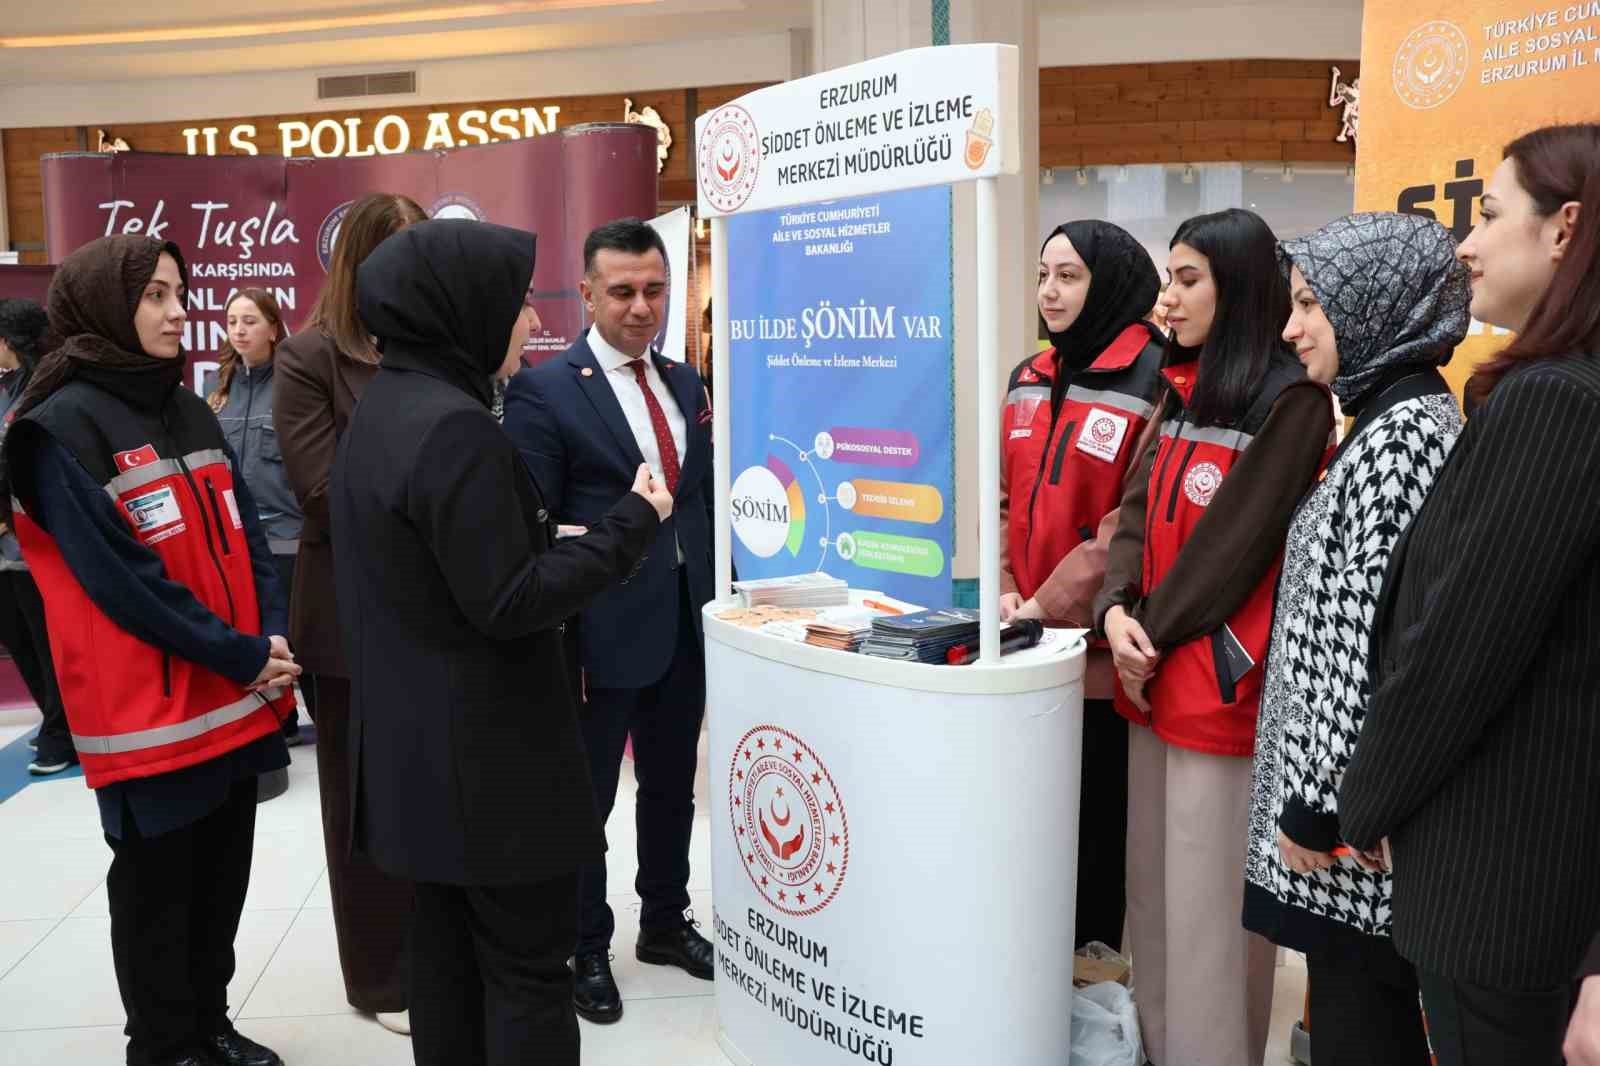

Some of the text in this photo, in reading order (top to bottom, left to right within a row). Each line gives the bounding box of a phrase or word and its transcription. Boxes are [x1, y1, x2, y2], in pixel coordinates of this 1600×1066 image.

[1483, 10, 1558, 41] TÜRKİYE
[1483, 25, 1598, 62] AİLE SOSYAL
[1481, 54, 1568, 84] ERZURUM
[820, 73, 898, 110] ERZURUM
[278, 115, 410, 158] POLO
[761, 95, 974, 160] ŞİDDET ÖNLEME VE İZLEME
[777, 155, 841, 186] MERKEZİ
[844, 134, 952, 177] MÜDÜRLÜĞÜ
[98, 199, 300, 259] Tek Tuşla
[791, 228, 803, 241] VE
[803, 226, 836, 240] SOSYAL
[838, 222, 890, 237] HİZMETLER
[192, 262, 296, 280] KARŞISINDA
[730, 299, 943, 348] BU İLDE ŞÖNİM VAR
[731, 496, 788, 524] ŞÖNİM
[748, 908, 828, 967] ERZURUM
[718, 949, 893, 1066] MERKEZİ MÜDÜRLÜĞÜ
[744, 936, 806, 994] ÖNLEME
[812, 977, 835, 1008] VE
[842, 986, 924, 1038] İZLEME
